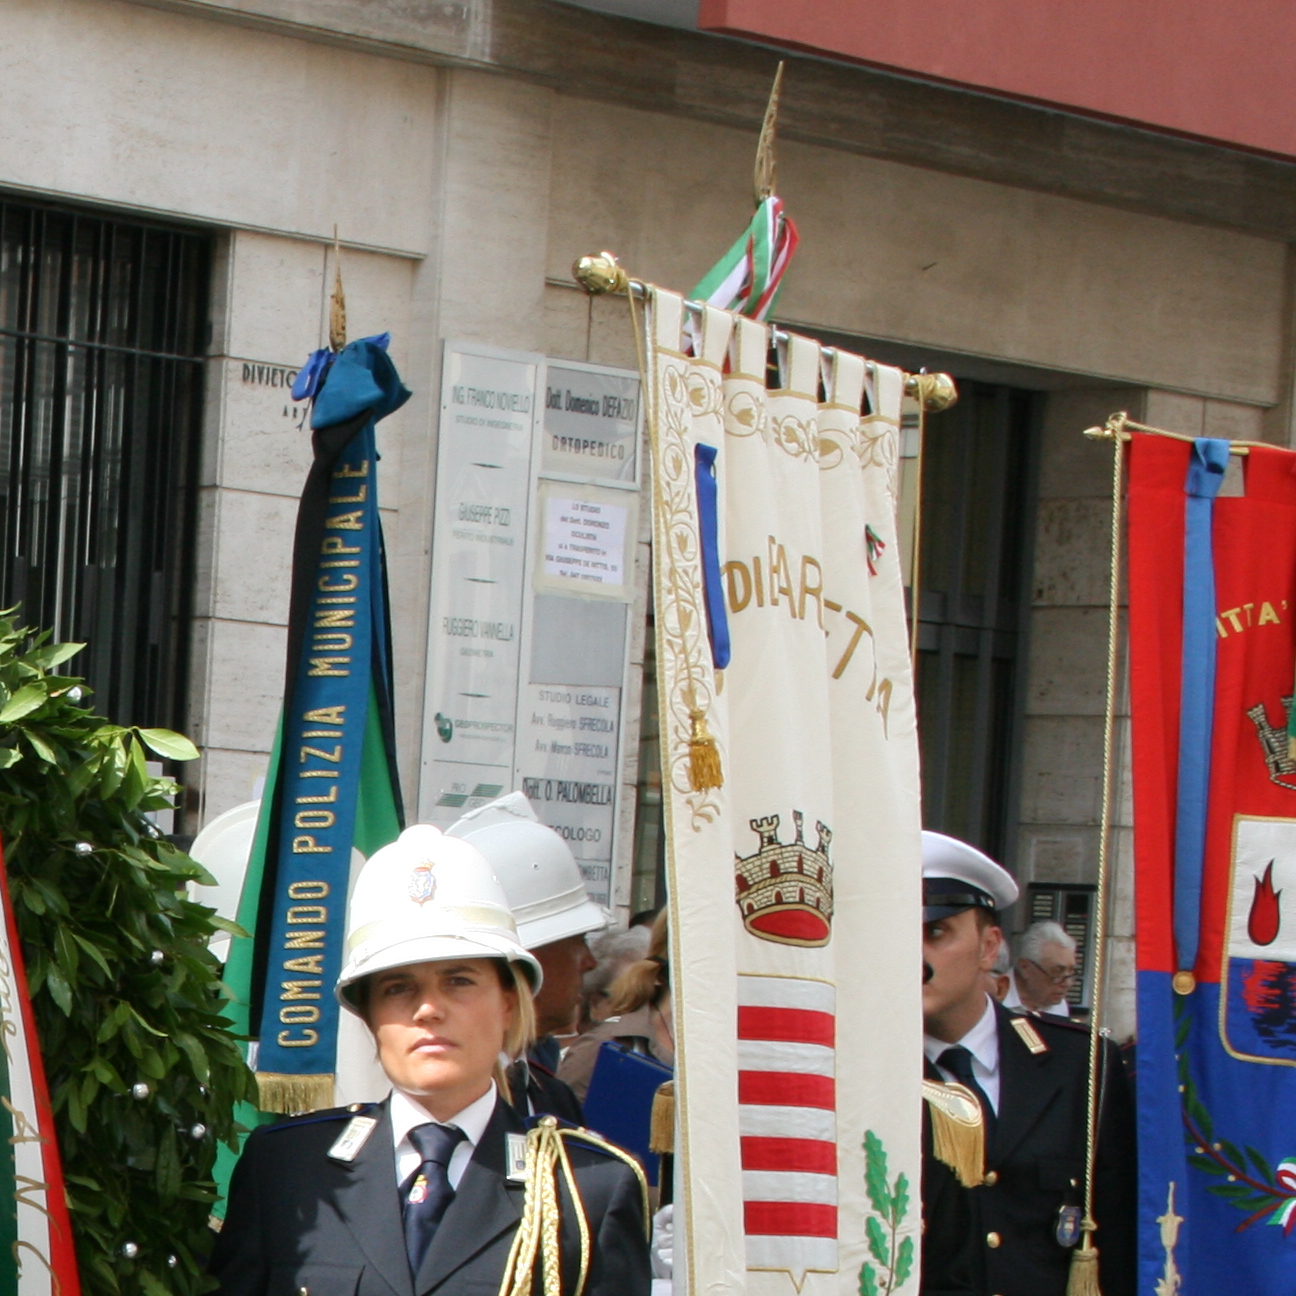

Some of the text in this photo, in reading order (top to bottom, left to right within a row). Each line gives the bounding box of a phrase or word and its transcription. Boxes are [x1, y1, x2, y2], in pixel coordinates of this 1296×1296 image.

[468, 387, 495, 410] FRANCO
[566, 390, 600, 416] Domenico
[552, 435, 625, 460] ORTOPEDICO
[459, 502, 493, 525] GIUSEPPE
[443, 617, 479, 638] RUGGIERO
[539, 692, 610, 708] STUDIO LEGALE
[548, 713, 576, 731] Ruggiero
[579, 716, 615, 733] SFRECOLA
[278, 458, 370, 1048] COMANDO POLIZIA MUNICIPALE
[574, 742, 609, 759] SFRECOLA
[557, 780, 613, 806] PALOMBELLA
